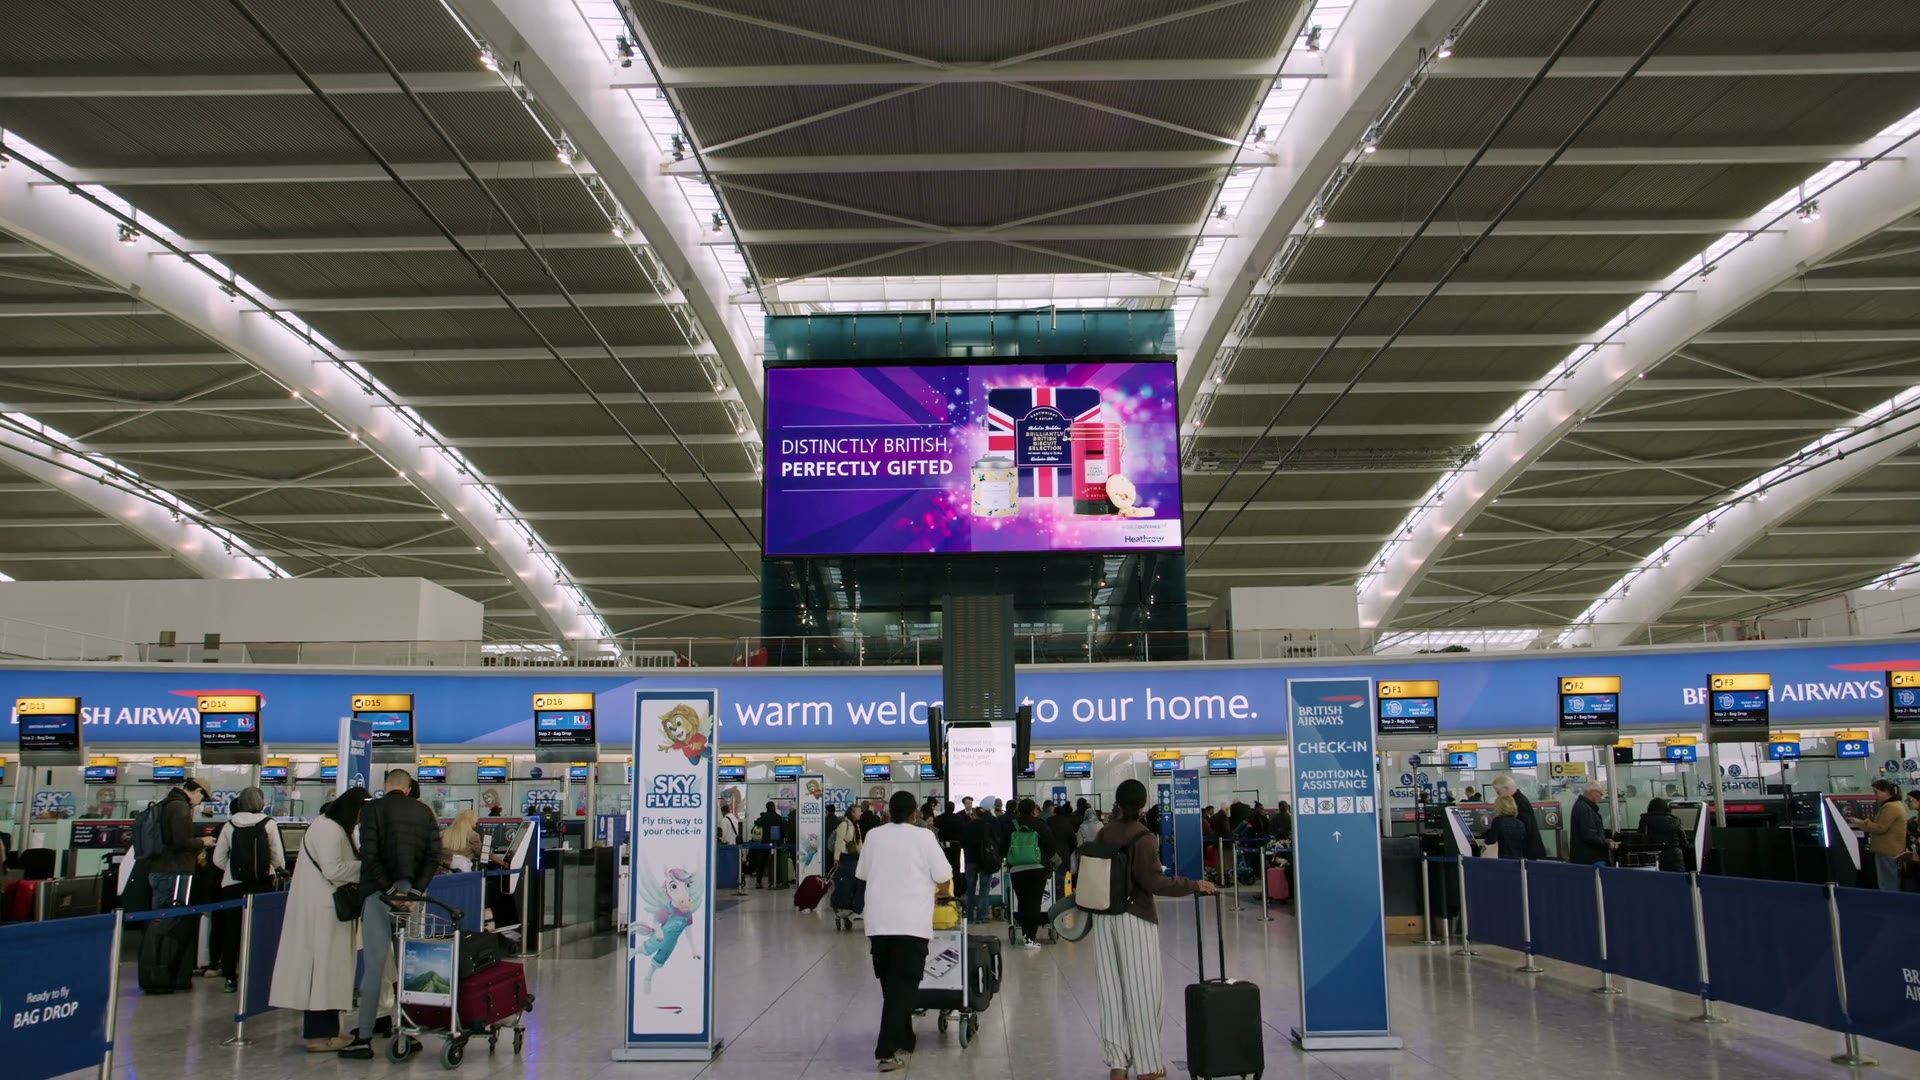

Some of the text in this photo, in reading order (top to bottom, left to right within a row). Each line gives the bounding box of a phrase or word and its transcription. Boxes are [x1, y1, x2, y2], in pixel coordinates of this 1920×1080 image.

[781, 437, 952, 455] DISTINCTLY BRITISH,
[781, 459, 953, 477] PERFECTLY GIFTED
[1124, 535, 1165, 543] Heathrow
[1780, 680, 1885, 702] AIRWAYS
[211, 700, 227, 708] D14
[365, 699, 381, 707] D15
[735, 701, 833, 727] warm
[846, 691, 944, 726] welc
[1072, 697, 1133, 723] our
[1146, 688, 1257, 721] home.
[1298, 705, 1342, 716] BRITISH
[1297, 716, 1344, 726] AIRWAYS
[1298, 741, 1367, 754] CHECK-IN
[1300, 769, 1368, 779] ADDITIONAL
[654, 775, 696, 794] SKY
[1302, 779, 1367, 790] ASSISTANCE
[35, 792, 72, 806] SKY
[528, 790, 557, 803] SKY
[646, 793, 701, 808] FLYERS
[642, 816, 703, 826] Fly this way to
[643, 827, 701, 837] your check-in
[26, 986, 70, 1004] Ready to fly
[13, 1001, 79, 1029] BAG DROP
